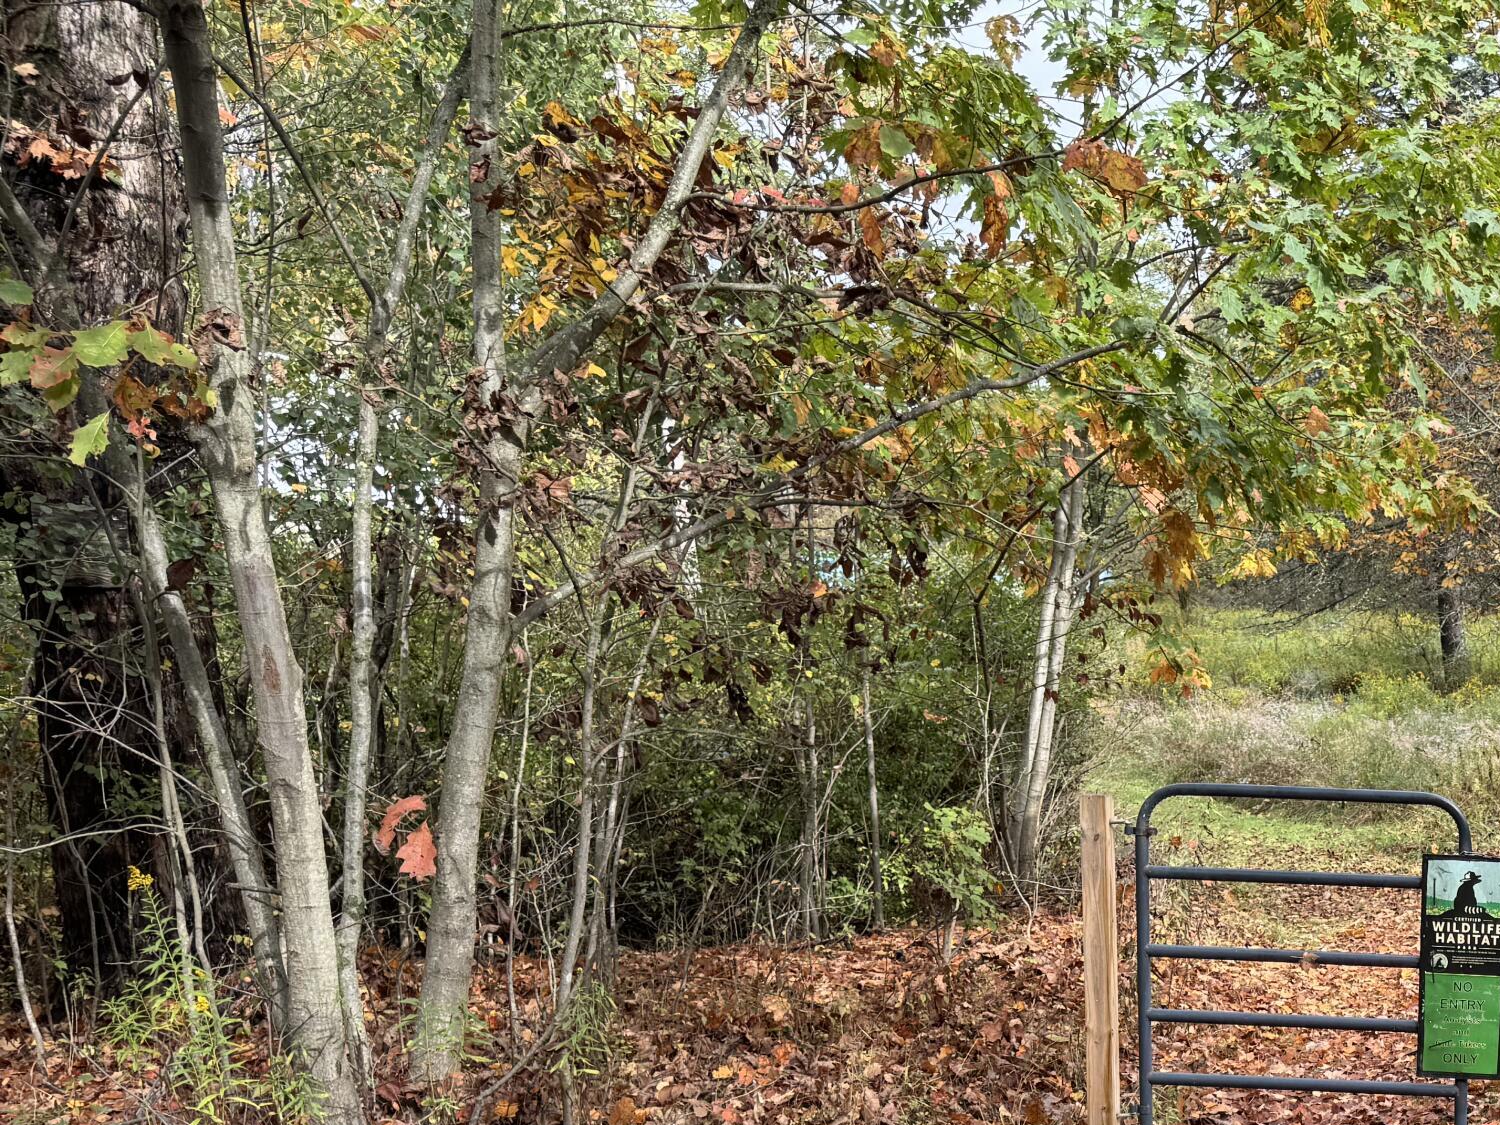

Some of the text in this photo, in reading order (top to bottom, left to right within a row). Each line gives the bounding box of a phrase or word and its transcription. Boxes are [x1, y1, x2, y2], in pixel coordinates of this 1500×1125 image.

[1435, 932, 1500, 946] HABITAT
[1453, 981, 1473, 993] NO
[1440, 998, 1485, 1011] ENTRY
[1443, 1053, 1479, 1064] ONLY
